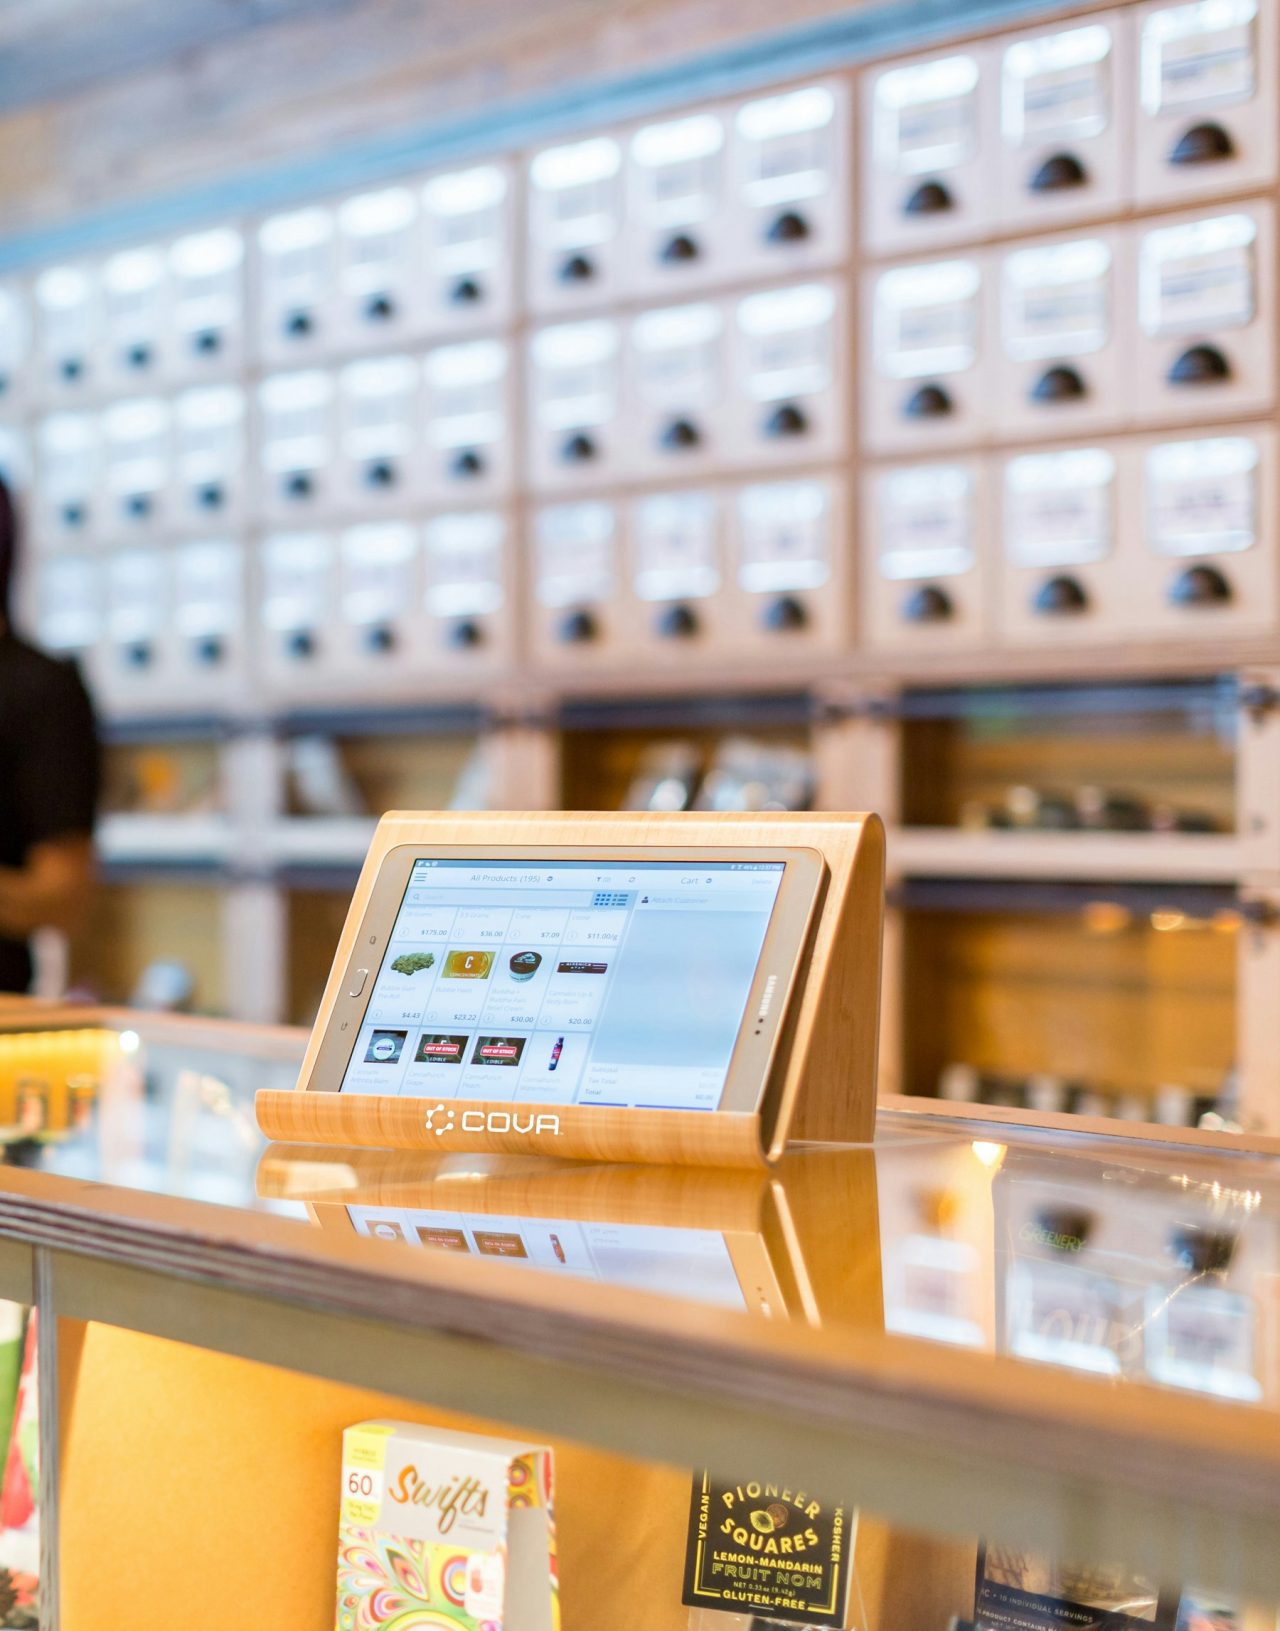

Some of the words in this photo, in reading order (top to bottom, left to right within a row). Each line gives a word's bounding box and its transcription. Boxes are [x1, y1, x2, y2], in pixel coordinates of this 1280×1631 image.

[520, 875, 540, 883] (195)
[680, 876, 698, 884] Cart
[462, 1111, 560, 1136] COVA
[1019, 1222, 1086, 1252] GREENERY
[348, 1472, 372, 1496] 60
[388, 1464, 489, 1534] Swifts
[722, 1481, 821, 1521] PIONEER
[698, 1495, 710, 1538] VEGAN
[720, 1518, 819, 1554] SQUARES
[831, 1508, 843, 1562] KOSHER
[714, 1550, 823, 1574] LEMON-MANDARIN
[712, 1562, 771, 1582] FRUIT
[776, 1572, 822, 1590] NOM
[723, 1590, 806, 1610] GLUTEN-FREE
[1010, 1596, 1052, 1614] INDIVIDUAL
[1054, 1608, 1094, 1623] SERVINGS
[982, 1611, 1010, 1622] PRODUCT
[1014, 1618, 1046, 1631] CONTAINS
